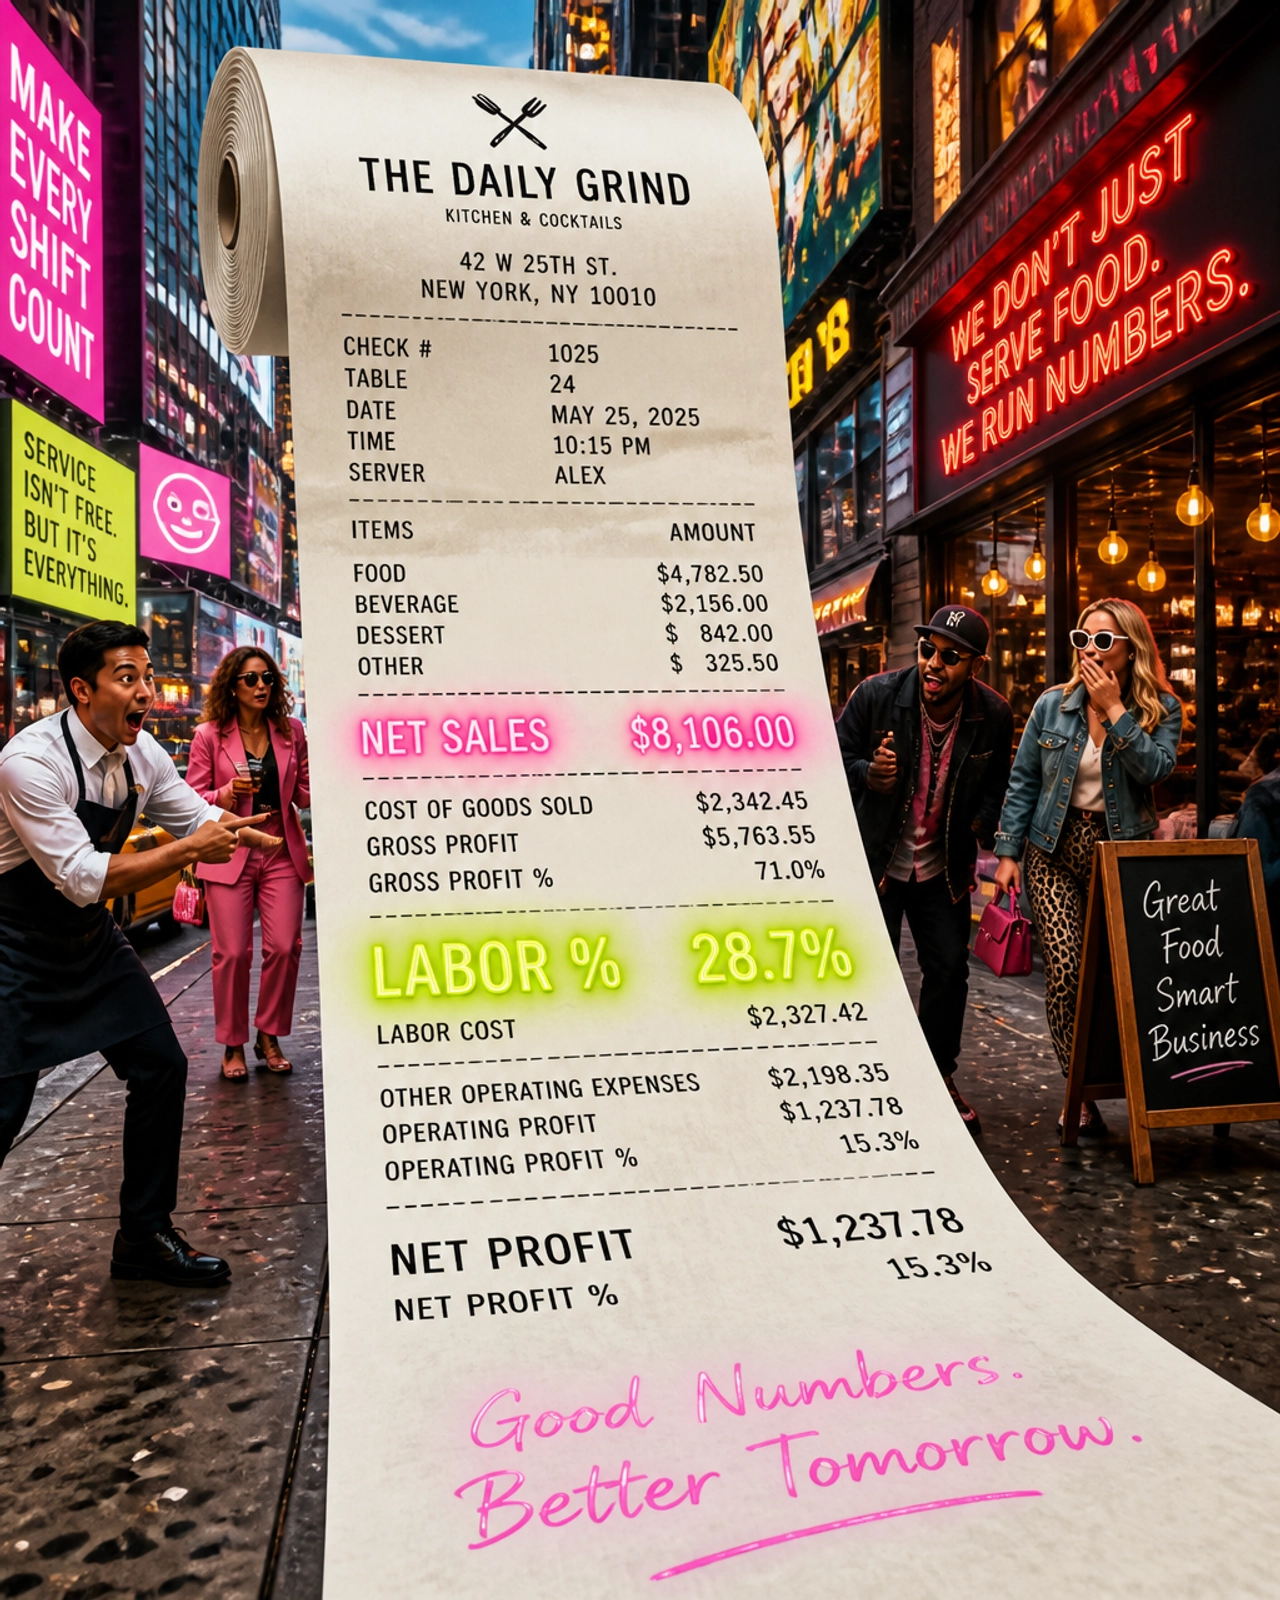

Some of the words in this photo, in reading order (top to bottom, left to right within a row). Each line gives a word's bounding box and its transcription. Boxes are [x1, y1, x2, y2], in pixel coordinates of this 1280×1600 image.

[10, 42, 91, 182] MAKE
[10, 119, 93, 244] EVERY
[358, 157, 434, 194] THE
[451, 161, 556, 200] DAILY
[576, 168, 690, 206] GRIND
[445, 208, 512, 225] KITCHEN
[520, 211, 531, 226] &
[539, 212, 623, 230] COCKTAILS
[951, 299, 986, 362] WE
[993, 210, 1081, 329] DON'T
[1091, 113, 1192, 244] JUST
[9, 199, 91, 310] SHIFT
[459, 251, 485, 272] 42
[495, 252, 513, 273] W
[523, 253, 575, 275] 25TH
[586, 256, 617, 276] ST.
[421, 278, 465, 300] NEW
[475, 280, 539, 306] YORK,
[551, 283, 579, 304] NY
[590, 285, 656, 307] 10010
[9, 272, 95, 380] COUNT
[967, 308, 1043, 405] SERVE
[1052, 230, 1160, 343] FOOD.
[343, 335, 410, 358] CHECK
[419, 339, 432, 358] #
[548, 343, 599, 364] 1025
[940, 419, 975, 475] WE
[982, 377, 1034, 452] RUN
[1046, 248, 1249, 412] NUMBERS.
[344, 367, 408, 389] TABLE
[550, 373, 576, 394] 24
[346, 399, 397, 420] DATE
[551, 404, 594, 425] MAY
[605, 406, 638, 429] 25,
[648, 406, 700, 427] 2025
[347, 430, 396, 451] TIME
[553, 435, 612, 455] 10:15
[622, 436, 651, 456] PM
[24, 431, 96, 493] SERVICE
[349, 462, 425, 483] SERVER
[554, 465, 606, 485] ALEX
[24, 470, 69, 514] ISN'T
[76, 495, 117, 541] FREE.
[24, 509, 60, 548] BUT
[67, 527, 97, 562] IT'S
[352, 520, 414, 540] ITEMS
[670, 522, 756, 542] AMOUNT
[24, 547, 128, 608] EVERYTHING.
[353, 563, 406, 583] FOOD
[657, 562, 764, 586] $4,782.50
[355, 594, 459, 614] BEVERAGE
[661, 592, 768, 615] $2,156.00
[356, 625, 445, 645] DESSERT
[665, 622, 679, 645] $
[700, 623, 773, 643] 842.00
[358, 656, 424, 676] OTHER
[670, 652, 683, 675] $
[705, 653, 779, 673] 325.50
[361, 720, 426, 755] NET
[442, 718, 549, 753] SALES
[631, 714, 794, 755] $8,106.00
[365, 800, 418, 821] COST
[427, 799, 452, 819] OF
[462, 797, 532, 818] GOODS
[540, 796, 593, 816] SOLD
[696, 790, 808, 815] $2,342.45
[367, 835, 436, 857] GROSS
[446, 833, 519, 855] PROFIT
[702, 824, 816, 850] $5,763.55
[369, 871, 440, 894] GROSS
[449, 868, 523, 891] PROFIT
[532, 867, 554, 888] %
[754, 859, 825, 880] 71.0%
[1143, 878, 1221, 922] Great
[692, 927, 852, 983] 28.7%
[1160, 924, 1224, 964] Food
[373, 939, 553, 998] LABOR
[570, 936, 621, 989] %
[1156, 972, 1239, 1013] Smart
[747, 1002, 868, 1029] $2,327.42
[377, 1022, 450, 1045] LABOR
[460, 1019, 515, 1041] COST
[1147, 1023, 1260, 1062] Business
[380, 1086, 452, 1108] OTHER
[461, 1079, 583, 1104] OPERATING
[591, 1072, 700, 1097] EXPENSES
[767, 1062, 889, 1090] $2,198.35
[779, 1096, 903, 1124] $1,237.78
[382, 1118, 509, 1144] OPERATING
[518, 1113, 596, 1137] PROFIT
[839, 1130, 920, 1154] 15.3%
[385, 1154, 515, 1181] OPERATING
[524, 1149, 604, 1173] PROFIT
[615, 1147, 638, 1168] %
[777, 1207, 964, 1250] $1,237.78
[391, 1239, 468, 1276] NET
[487, 1228, 632, 1270] PROFIT
[886, 1251, 993, 1280] 15.3%
[394, 1295, 452, 1322] NET
[467, 1286, 573, 1317] PROFIT
[587, 1283, 619, 1307] %
[469, 1375, 655, 1453] Good
[696, 1348, 1023, 1424] Numbers.
[453, 1459, 721, 1551] Better
[745, 1416, 1143, 1499] Tomorrow.
